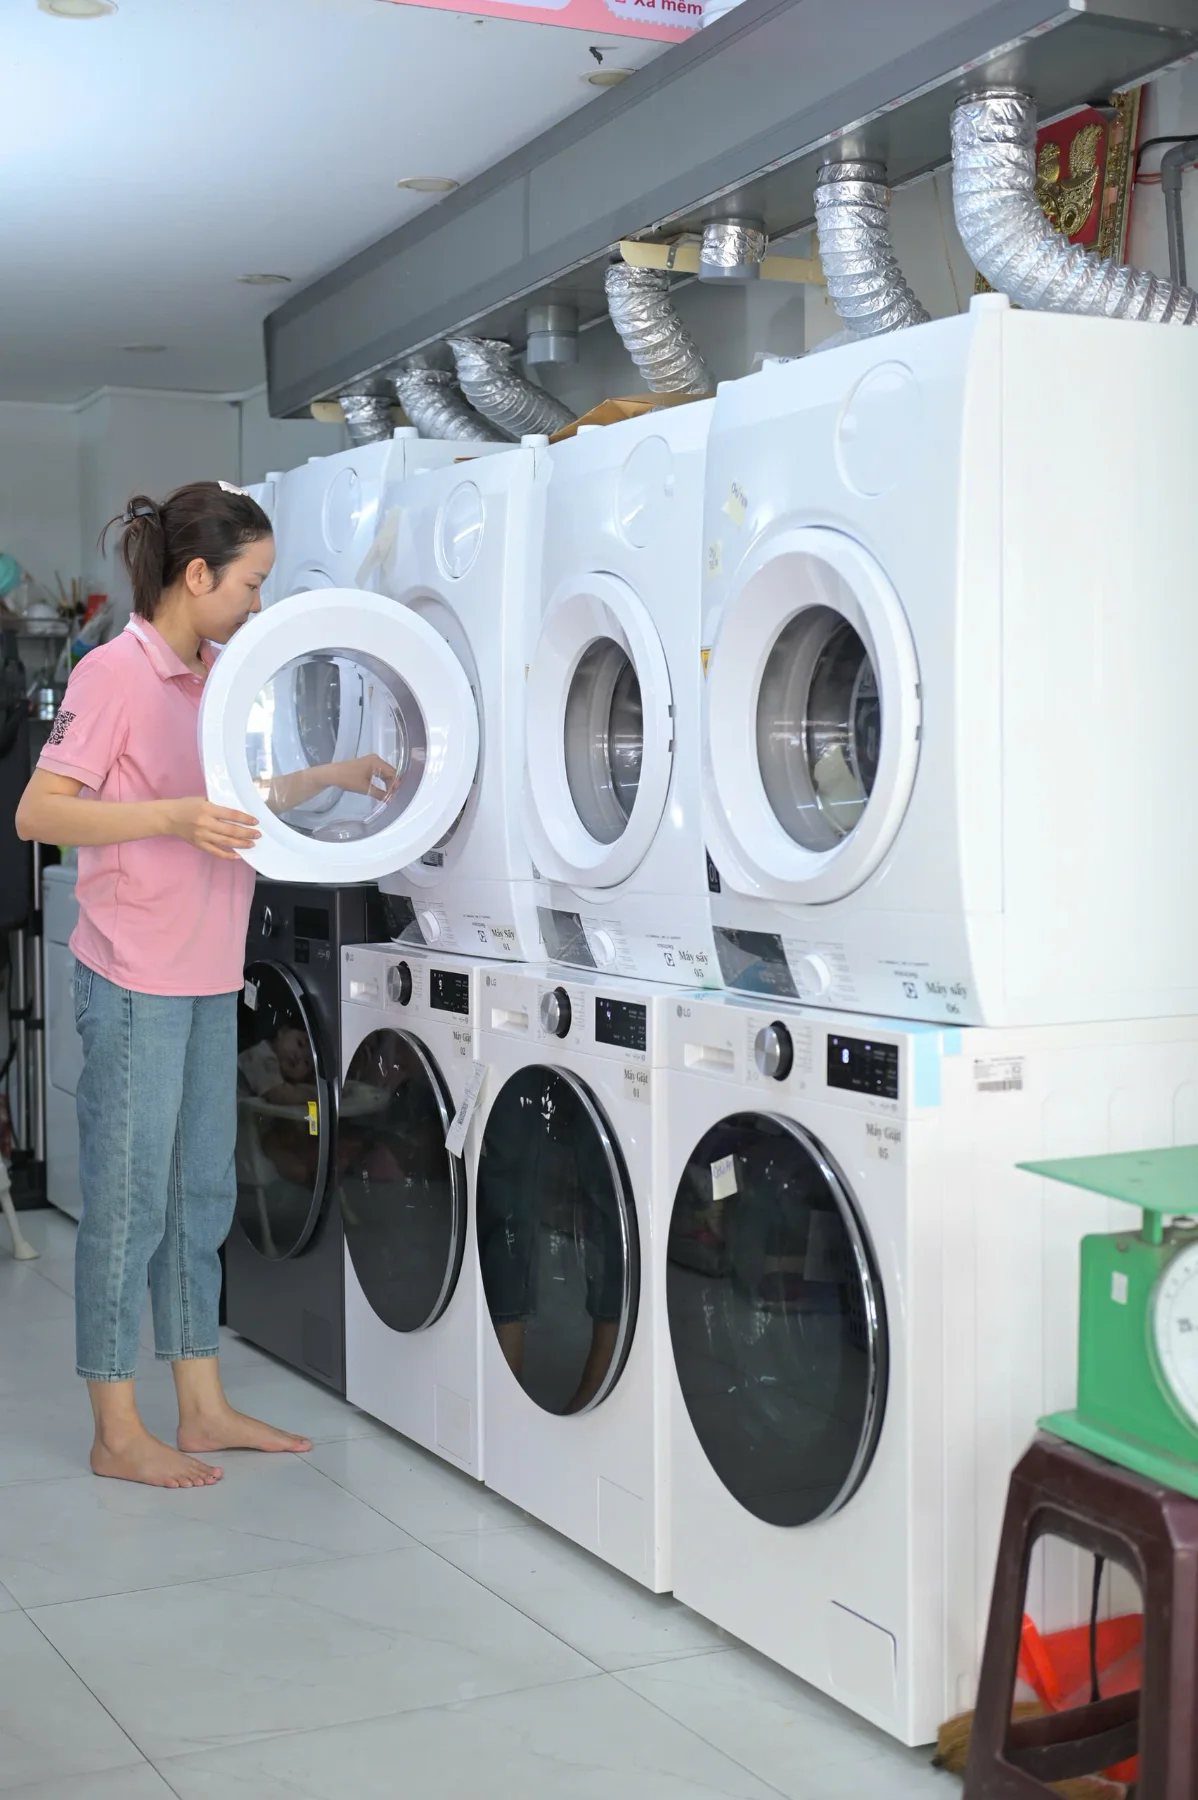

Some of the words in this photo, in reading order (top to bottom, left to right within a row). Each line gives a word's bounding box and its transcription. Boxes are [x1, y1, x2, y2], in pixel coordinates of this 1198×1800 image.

[502, 942, 511, 951] 01
[678, 950, 694, 964] Máy
[695, 951, 708, 965] sấy
[693, 968, 704, 978] 05
[925, 981, 948, 998] Máy
[624, 1069, 635, 1084] Máy
[632, 1087, 640, 1098] 01
